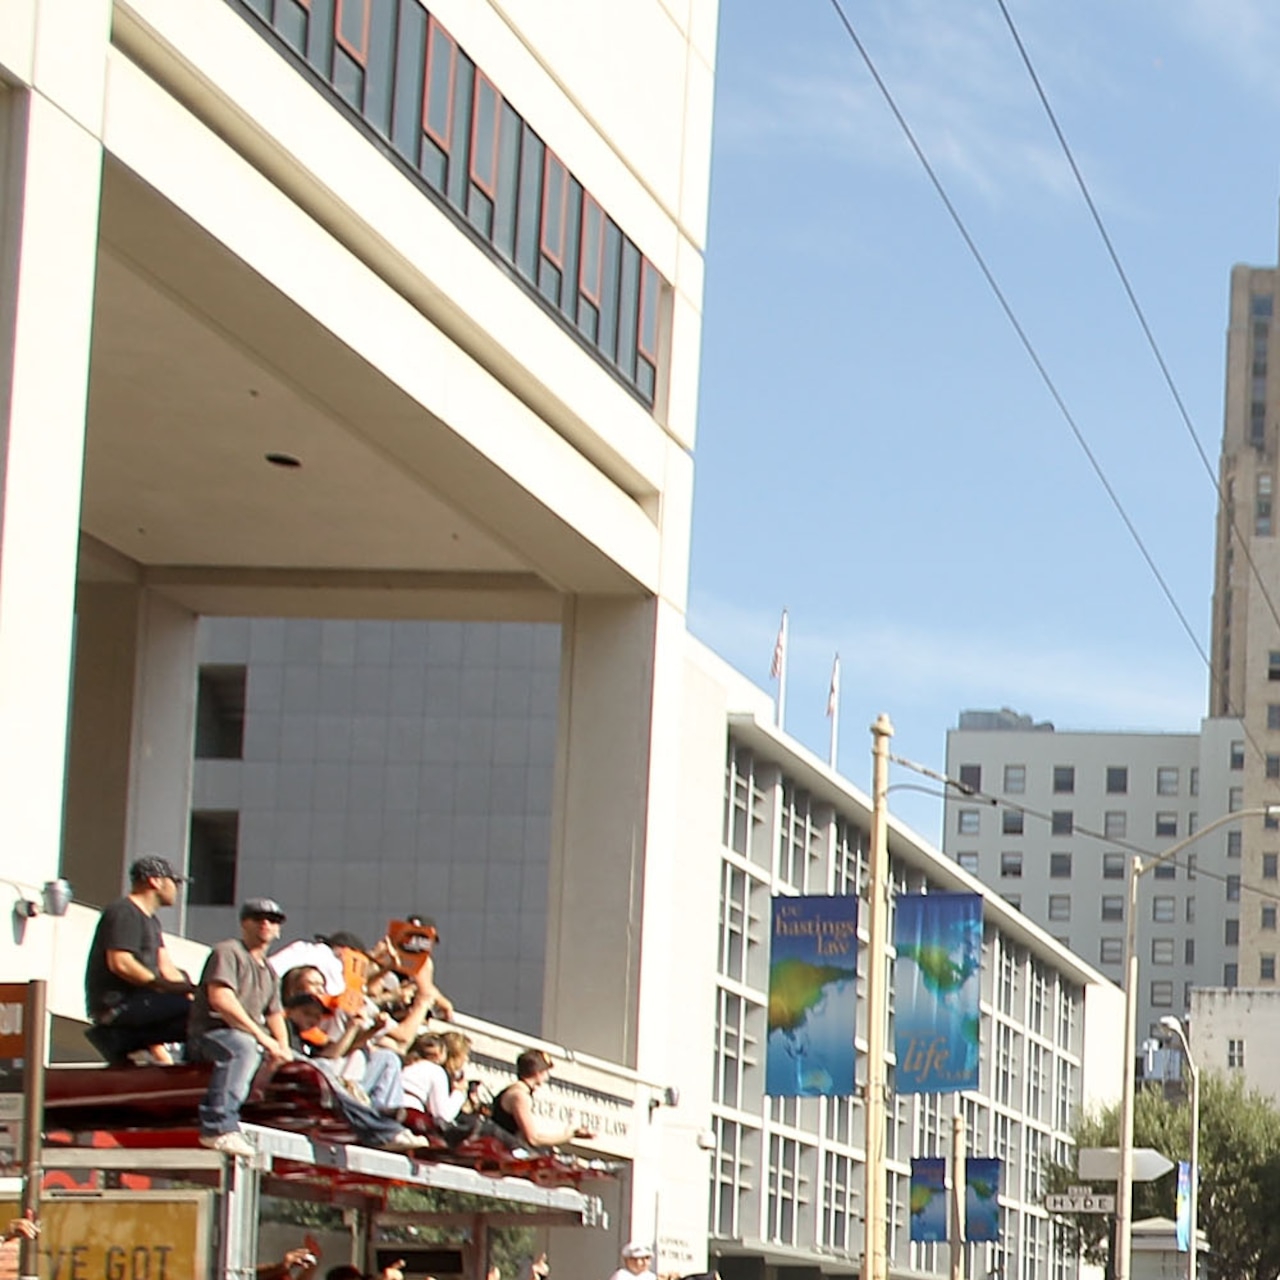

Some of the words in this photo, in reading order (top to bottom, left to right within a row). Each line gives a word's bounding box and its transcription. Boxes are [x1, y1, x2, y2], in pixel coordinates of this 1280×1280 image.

[775, 912, 854, 941] hastings
[902, 1036, 950, 1083] life
[605, 1117, 630, 1136] LAW
